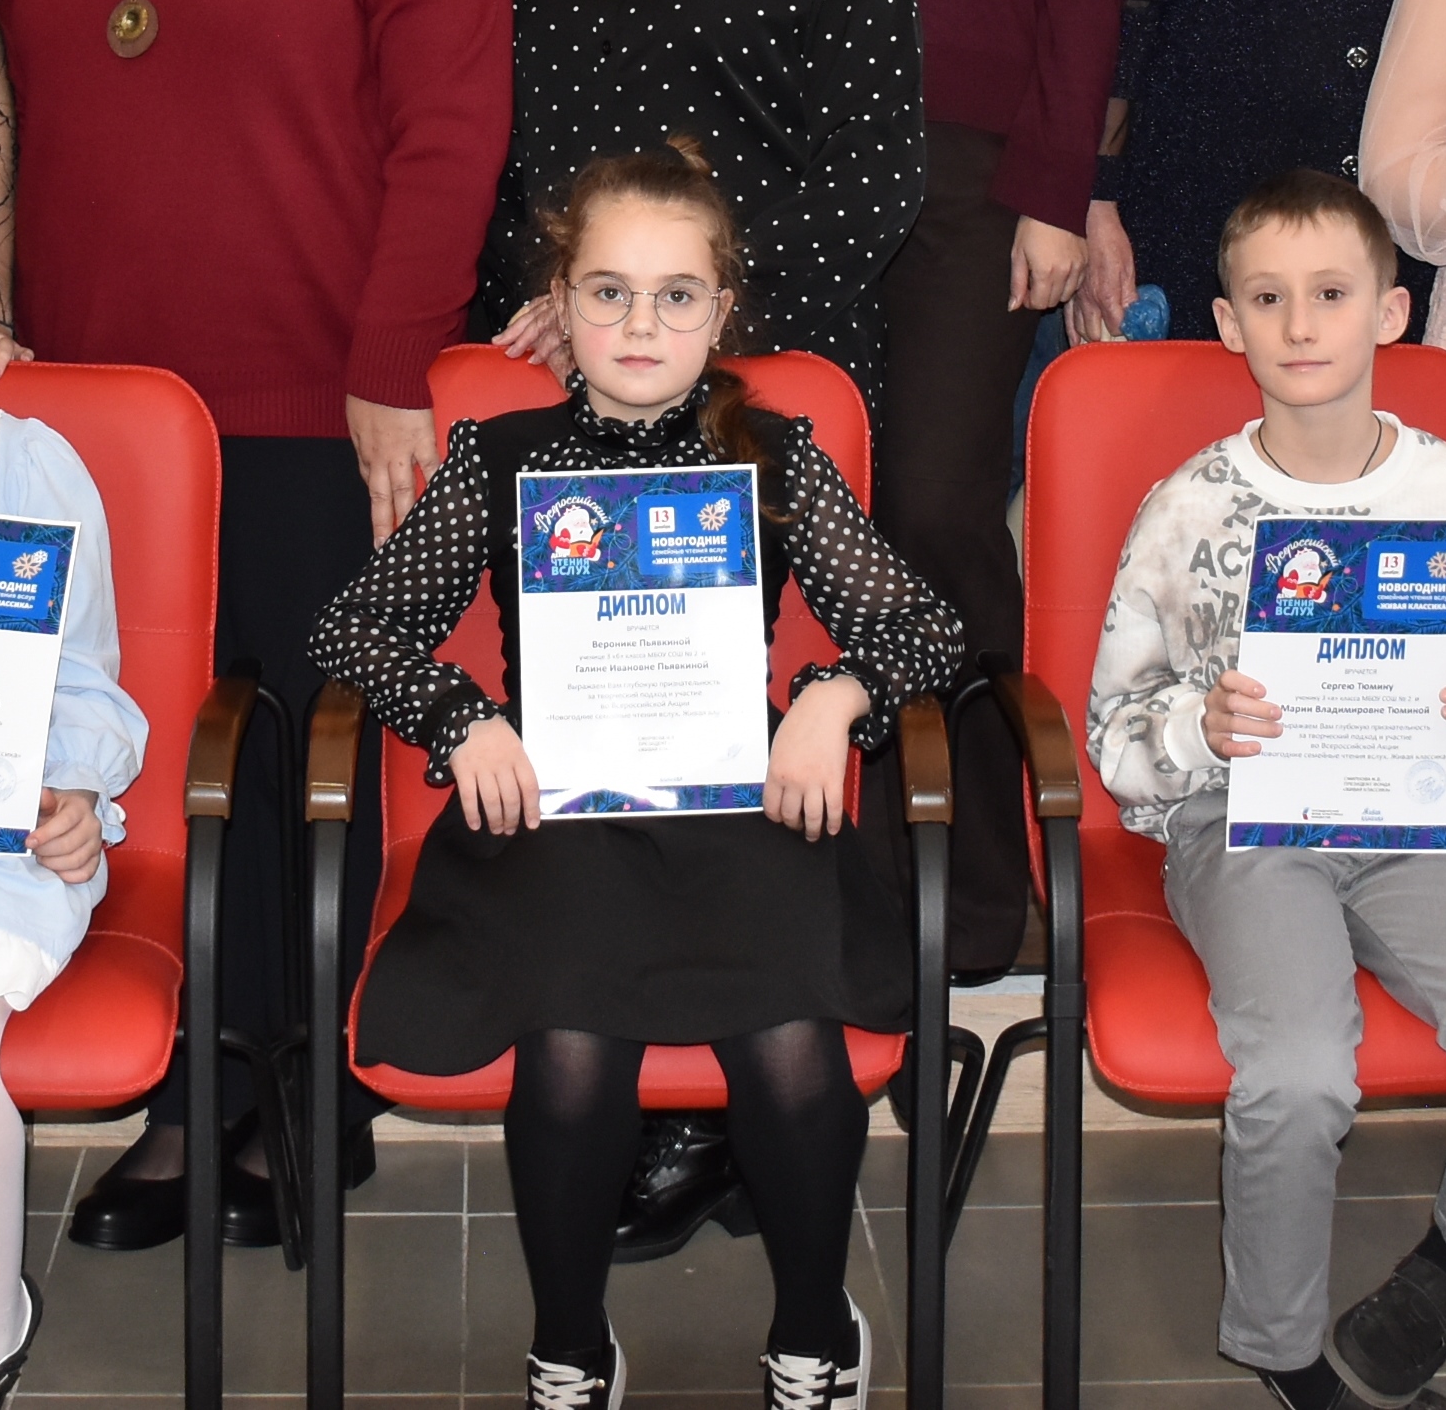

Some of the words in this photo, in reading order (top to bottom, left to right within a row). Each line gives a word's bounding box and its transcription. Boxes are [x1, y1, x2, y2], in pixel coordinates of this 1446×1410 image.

[654, 509, 669, 522] 13
[651, 535, 727, 548] НОВОГОДНИЕ
[551, 557, 589, 566] ЧТЕНИЯ
[652, 557, 682, 565] «ЖИВАЯ
[684, 555, 726, 564] КЛАССИКА»
[1383, 556, 1399, 567] 13
[551, 565, 590, 575] ВСЛУХ
[596, 592, 685, 621] ДИПЛОМ
[1276, 599, 1315, 607] ЧТЕНИЯ
[1275, 607, 1314, 616] ВСЛУХ
[1316, 637, 1405, 663] ДИПЛОМ
